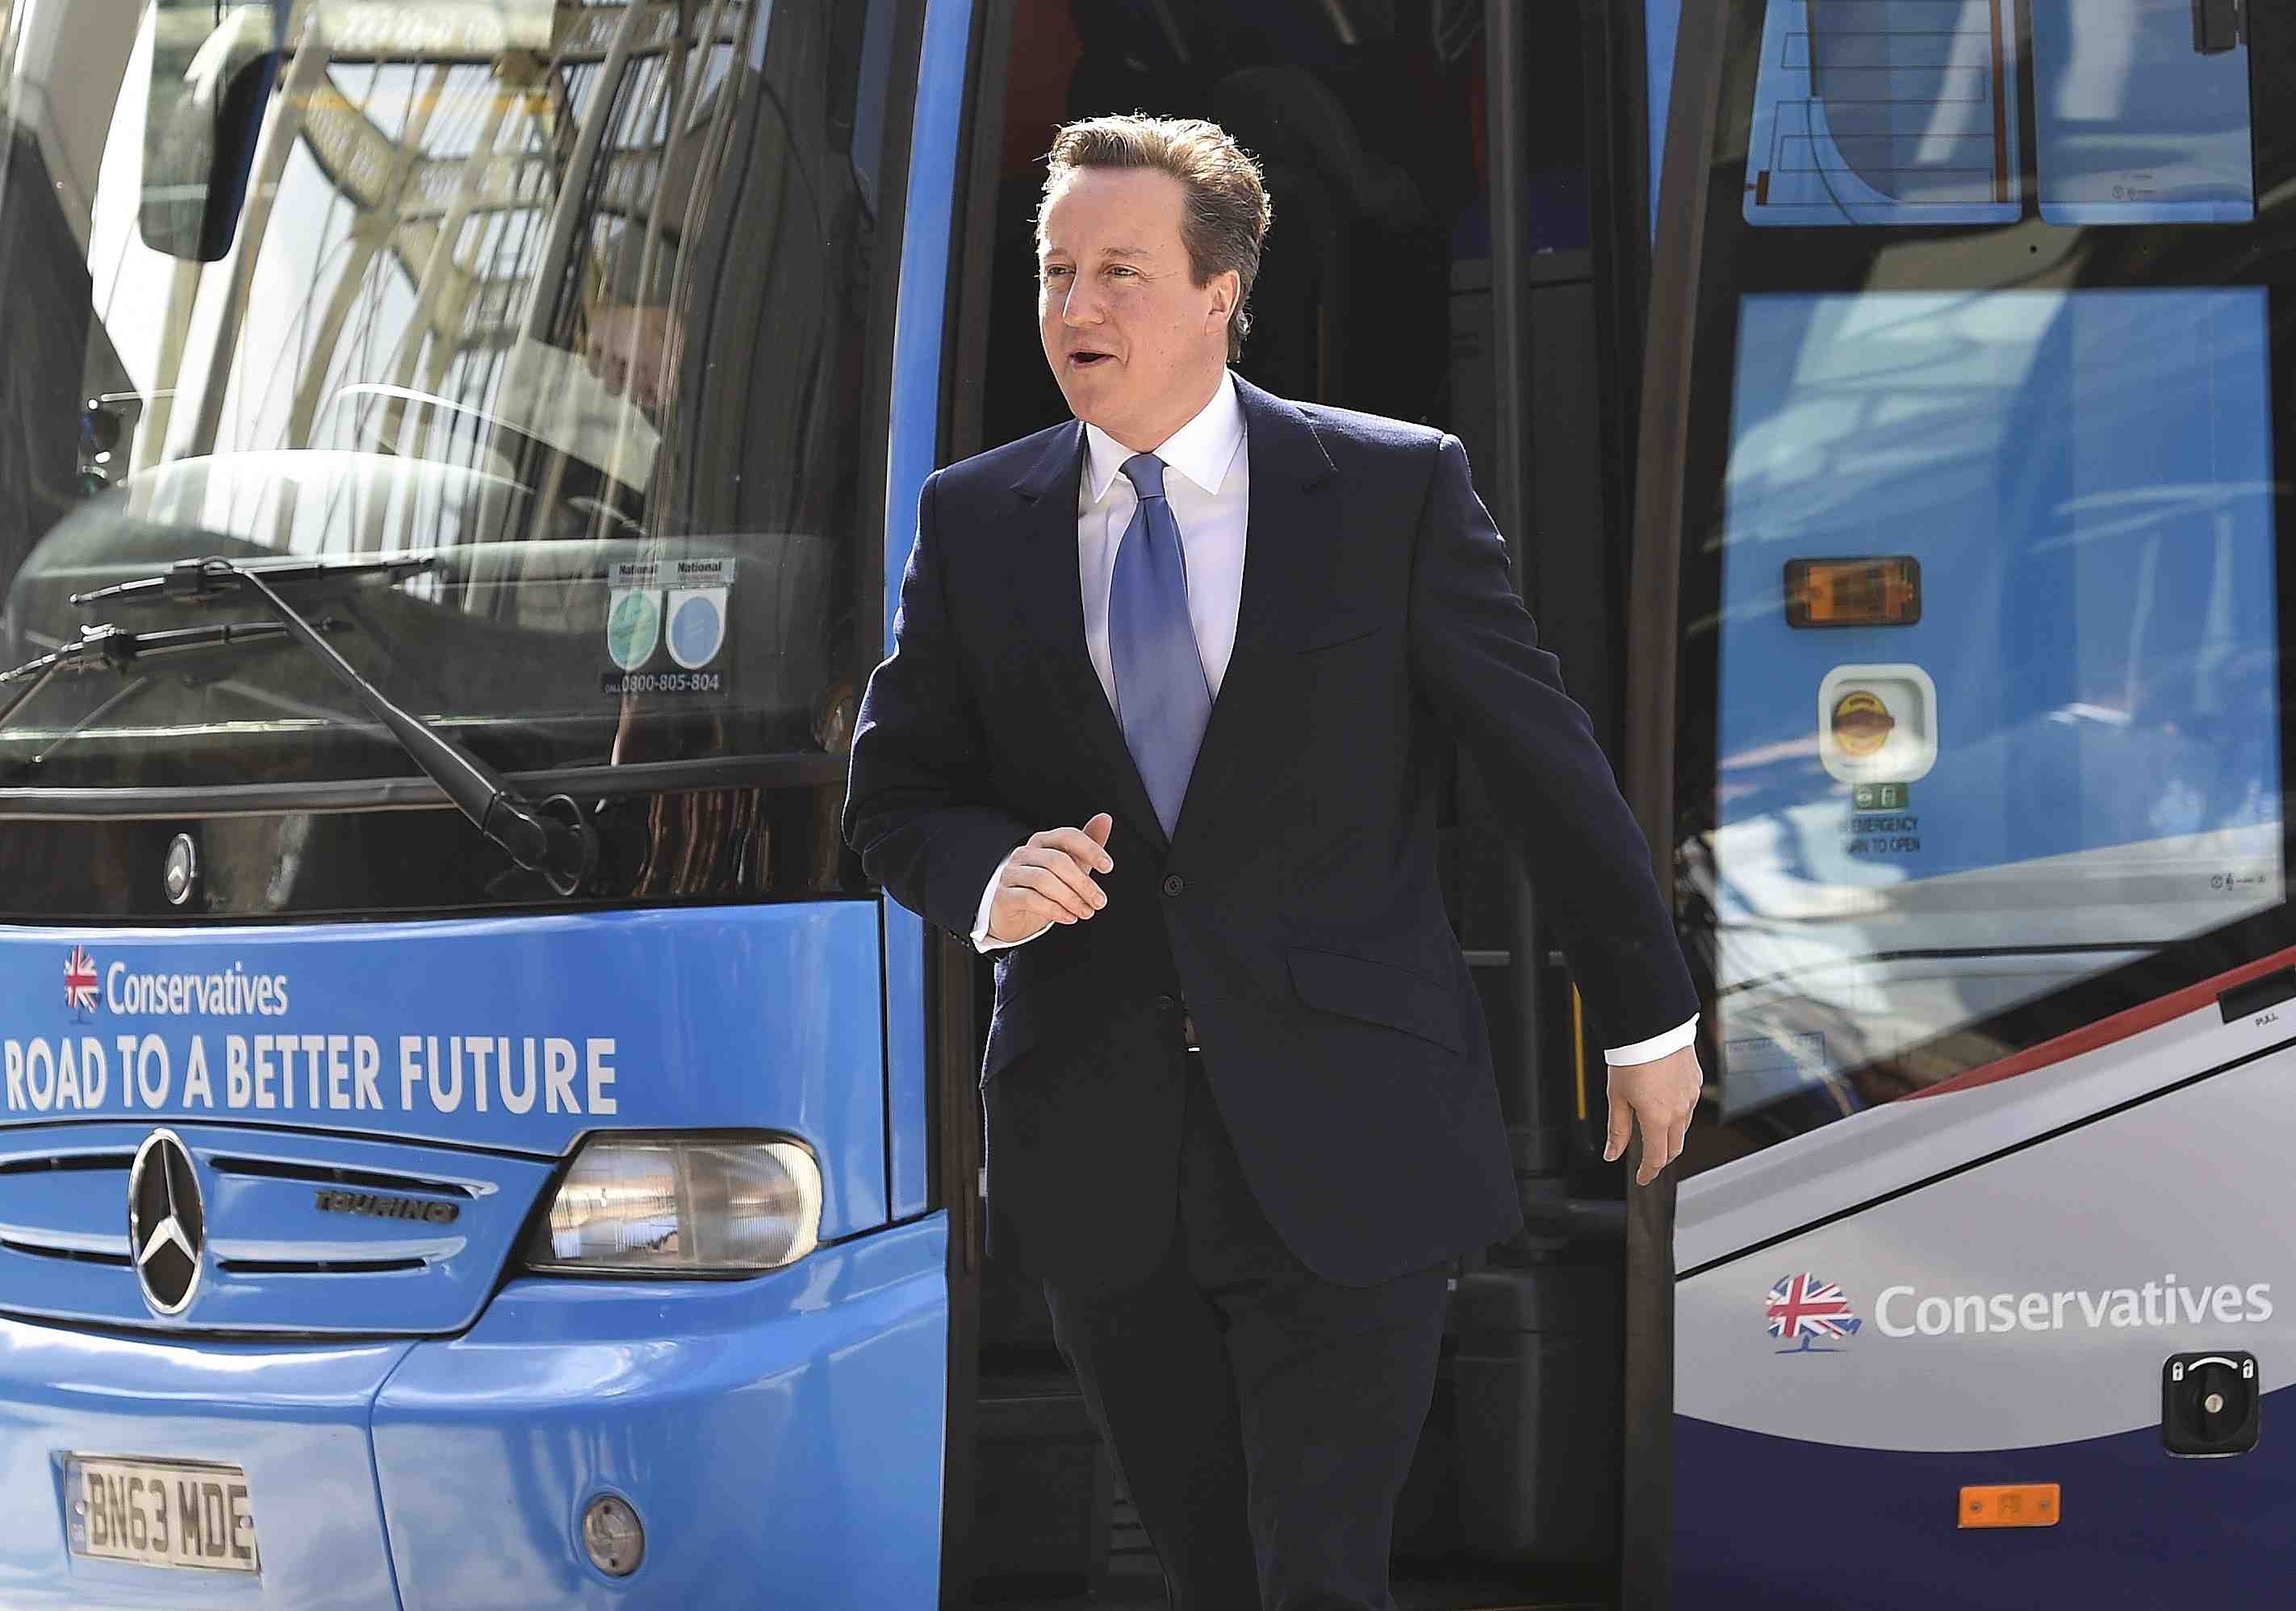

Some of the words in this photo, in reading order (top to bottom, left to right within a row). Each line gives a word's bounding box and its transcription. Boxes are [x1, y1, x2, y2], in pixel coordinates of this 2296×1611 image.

[678, 562, 721, 572] National
[621, 673, 720, 692] 0800-805-804
[1853, 817, 1918, 832] EMERGENCY
[1872, 839, 1887, 852] TO
[1889, 837, 1920, 852] OPEN
[107, 960, 288, 1015] Conservatives
[3, 1037, 108, 1111] ROAD
[117, 1032, 169, 1110] TO
[182, 1034, 214, 1109] A
[226, 1034, 384, 1111] BETTER
[399, 1036, 617, 1115] FUTURE
[316, 1190, 459, 1223] TOURING
[1874, 1274, 2273, 1338] Conservatives
[86, 1473, 168, 1553] BN63
[177, 1481, 253, 1559] MDE
